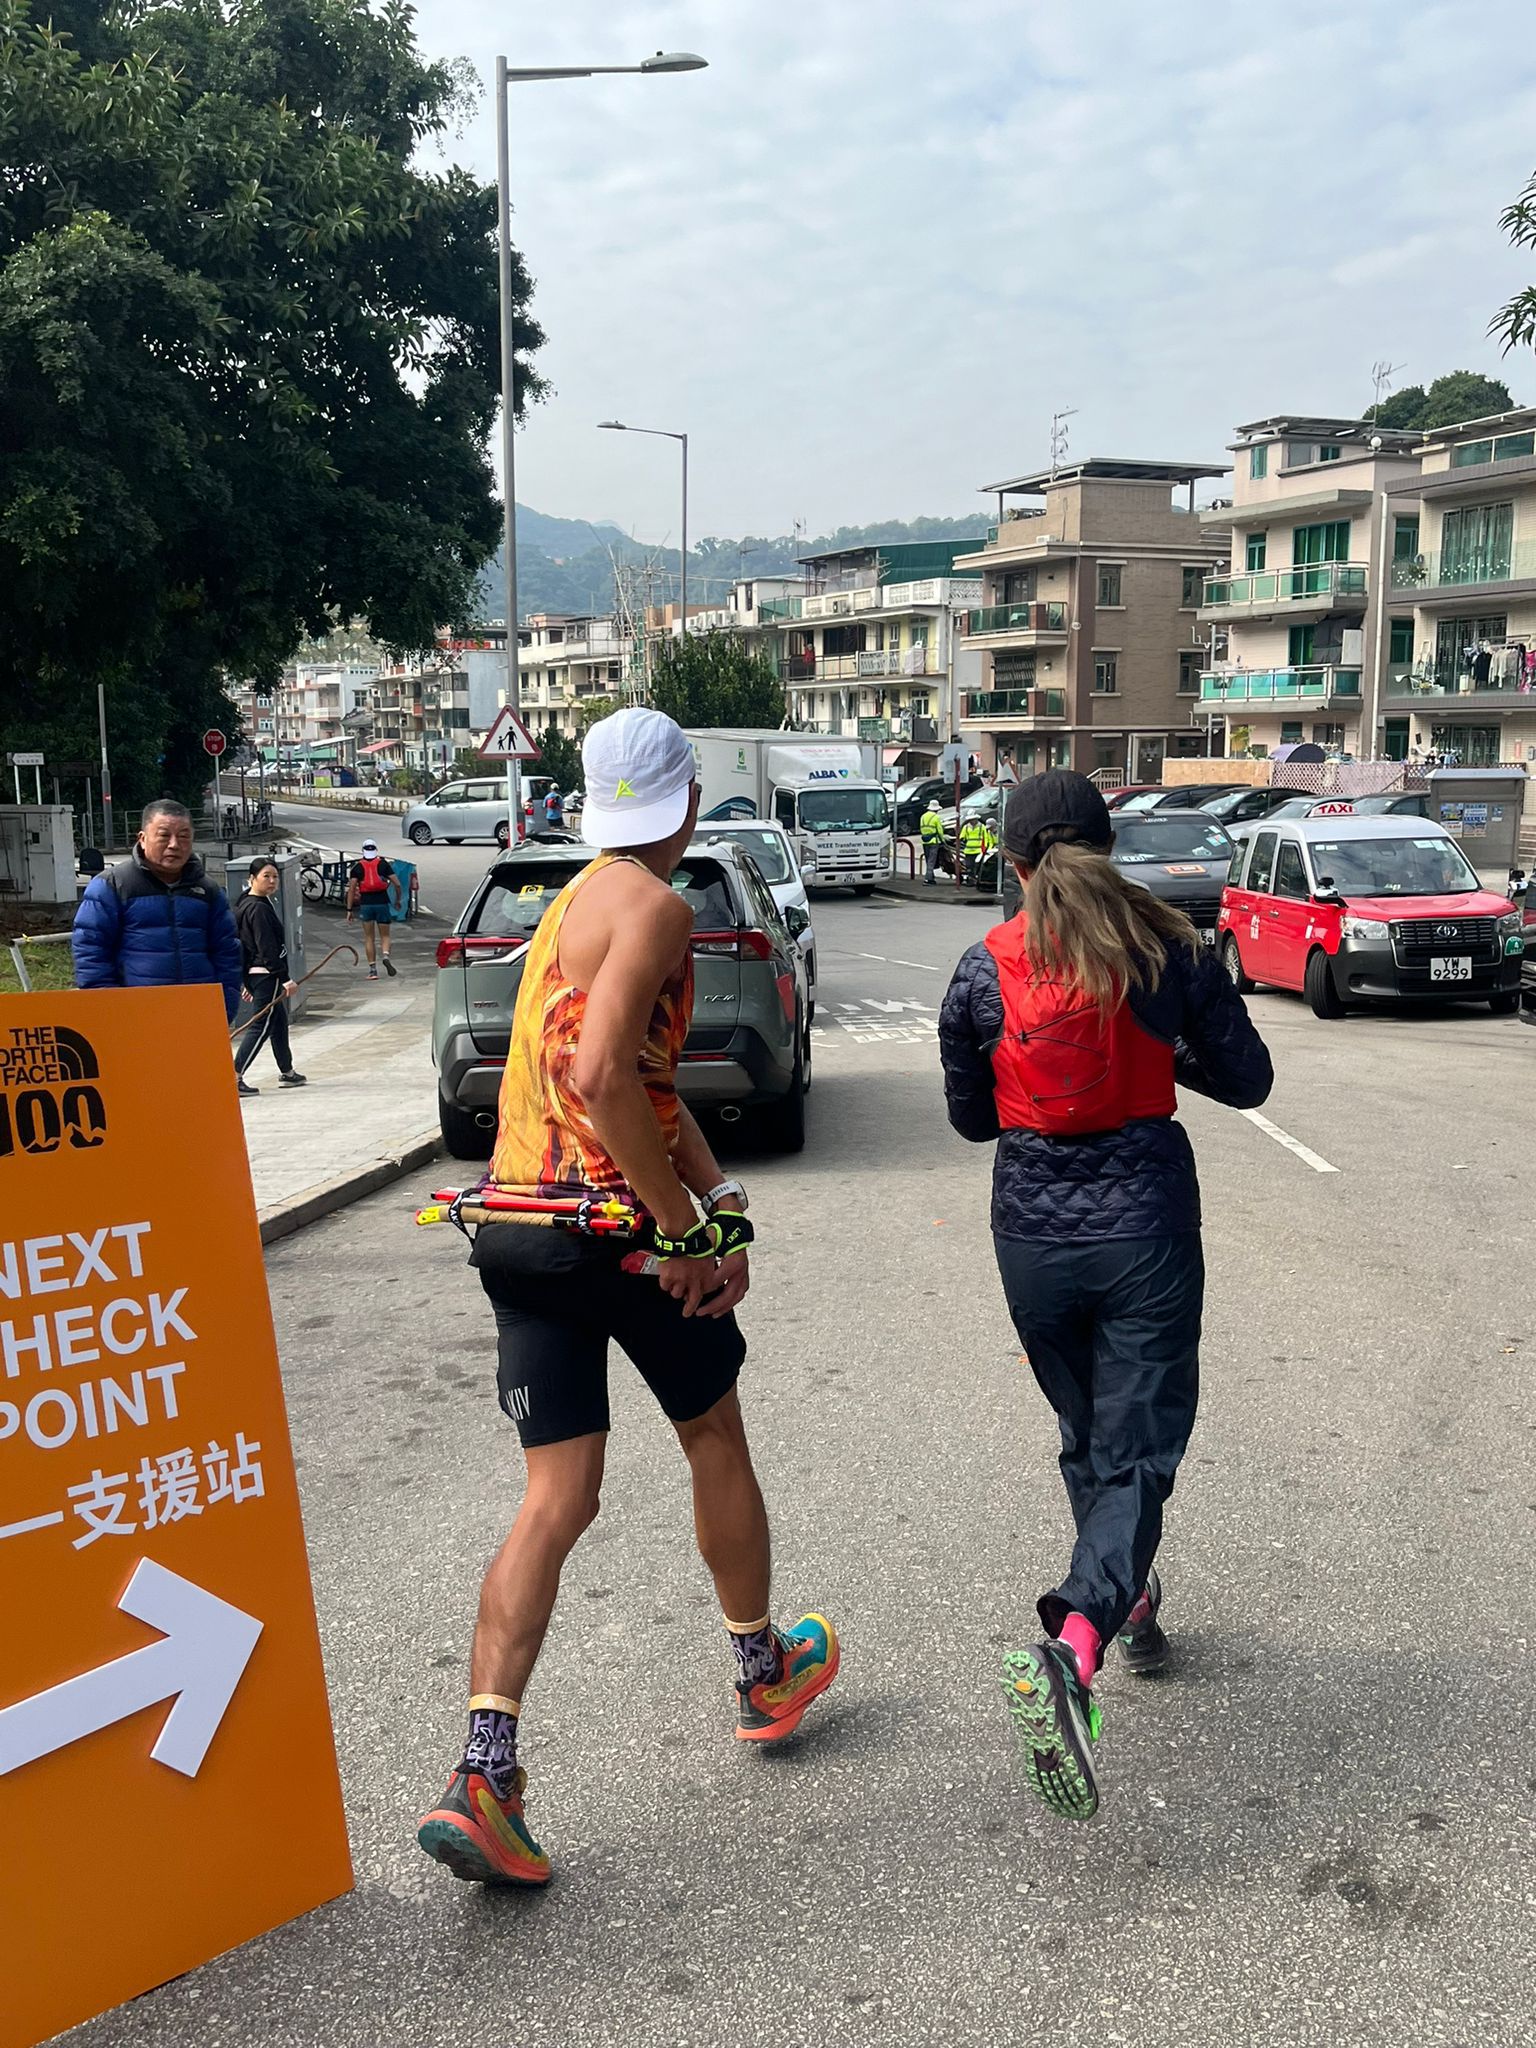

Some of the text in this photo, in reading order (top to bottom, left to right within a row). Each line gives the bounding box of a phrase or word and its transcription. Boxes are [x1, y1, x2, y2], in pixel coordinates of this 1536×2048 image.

[808, 770, 838, 780] ALBA
[1319, 804, 1353, 814] TAXI
[1443, 958, 1460, 969] YW
[1433, 969, 1469, 981] 9299
[9, 1026, 54, 1046] THE
[0, 1045, 57, 1067] ORTH
[2, 1064, 60, 1086] FACE
[0, 1287, 198, 1378] HECK
